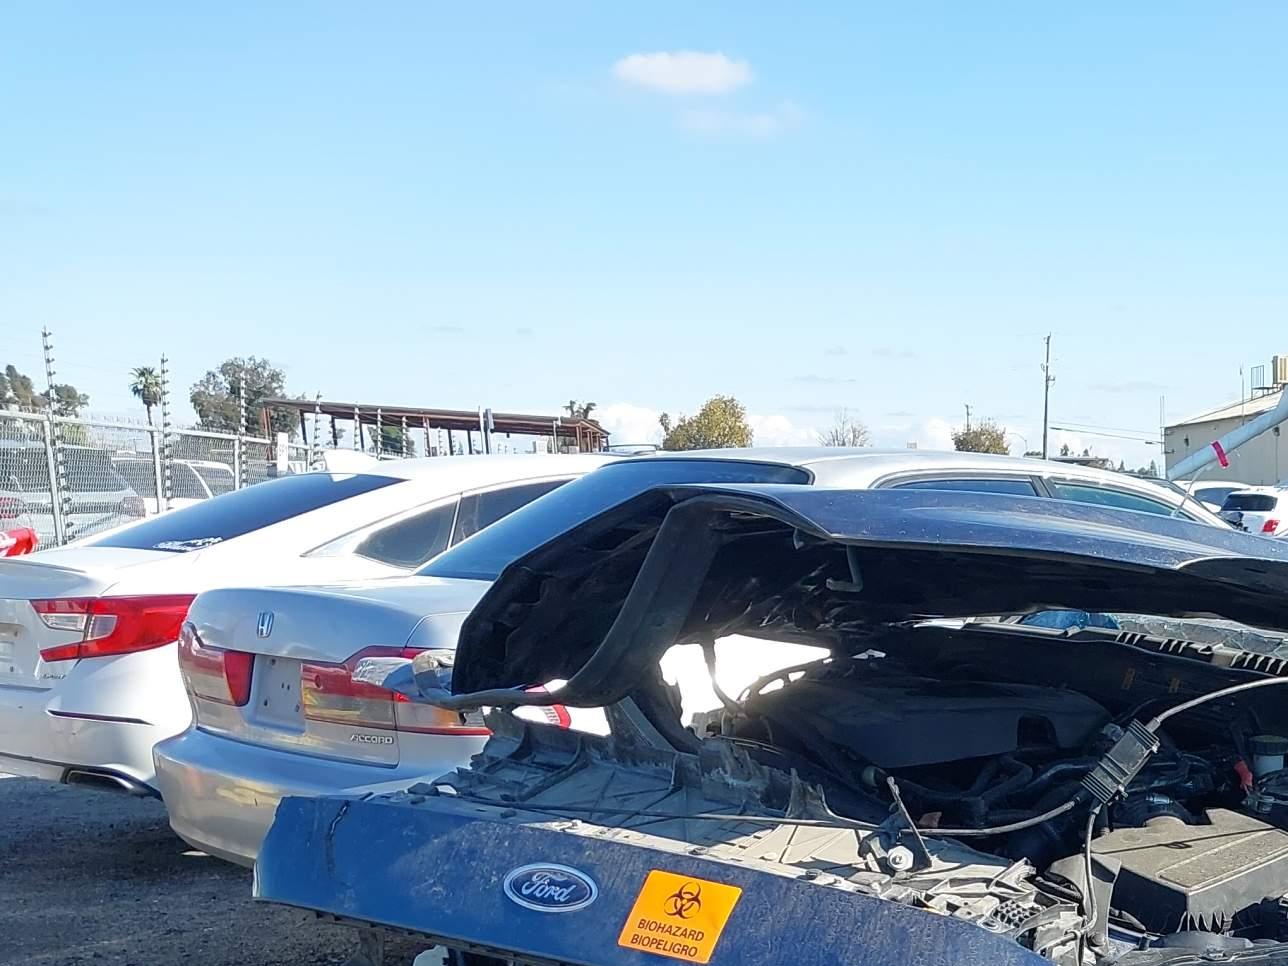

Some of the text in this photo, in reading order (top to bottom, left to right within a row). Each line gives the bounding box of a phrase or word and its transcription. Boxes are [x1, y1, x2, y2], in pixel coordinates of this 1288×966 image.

[350, 733, 394, 744] ACCORD
[520, 871, 578, 903] Ford
[637, 918, 705, 942] BIOHAZARD
[630, 933, 698, 958] BIOPELIGRO
